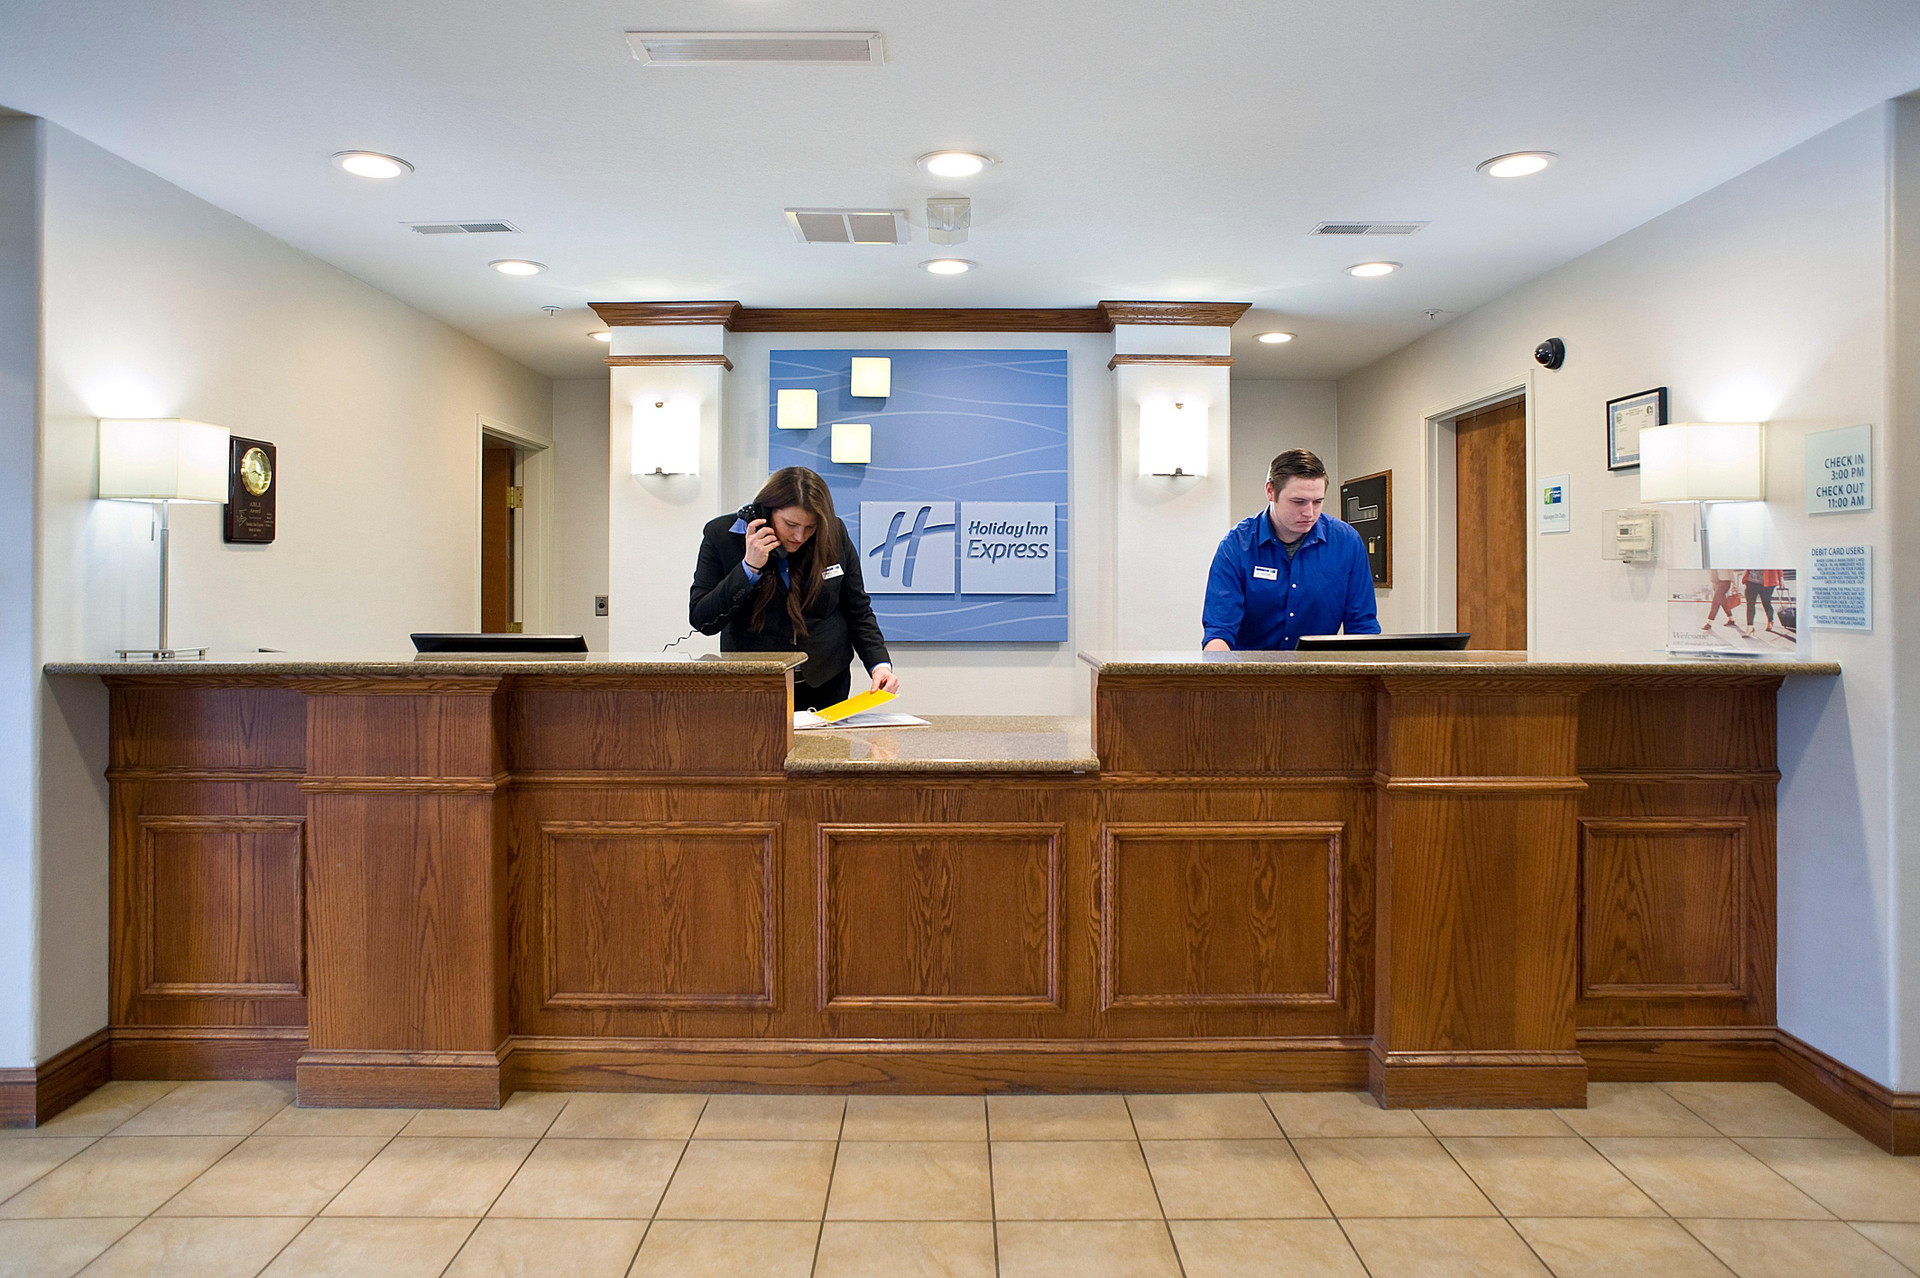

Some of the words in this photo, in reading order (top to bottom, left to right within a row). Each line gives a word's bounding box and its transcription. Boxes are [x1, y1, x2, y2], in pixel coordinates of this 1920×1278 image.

[1824, 455, 1853, 469] CHECK
[1854, 453, 1864, 465] IN
[1831, 468, 1849, 480] 3:00
[1851, 466, 1864, 478] PM
[1816, 484, 1844, 497] CHECK
[1846, 482, 1864, 494] OUT
[1828, 497, 1848, 508] 11:00
[1850, 495, 1864, 506] AM
[968, 521, 1024, 538] Holiday
[1026, 521, 1048, 535] Inn
[967, 539, 1050, 564] Express
[1811, 547, 1827, 556] DEBIT
[1828, 547, 1845, 556] CARD
[1845, 546, 1865, 555] USERS
[1673, 631, 1709, 640] Welcome
